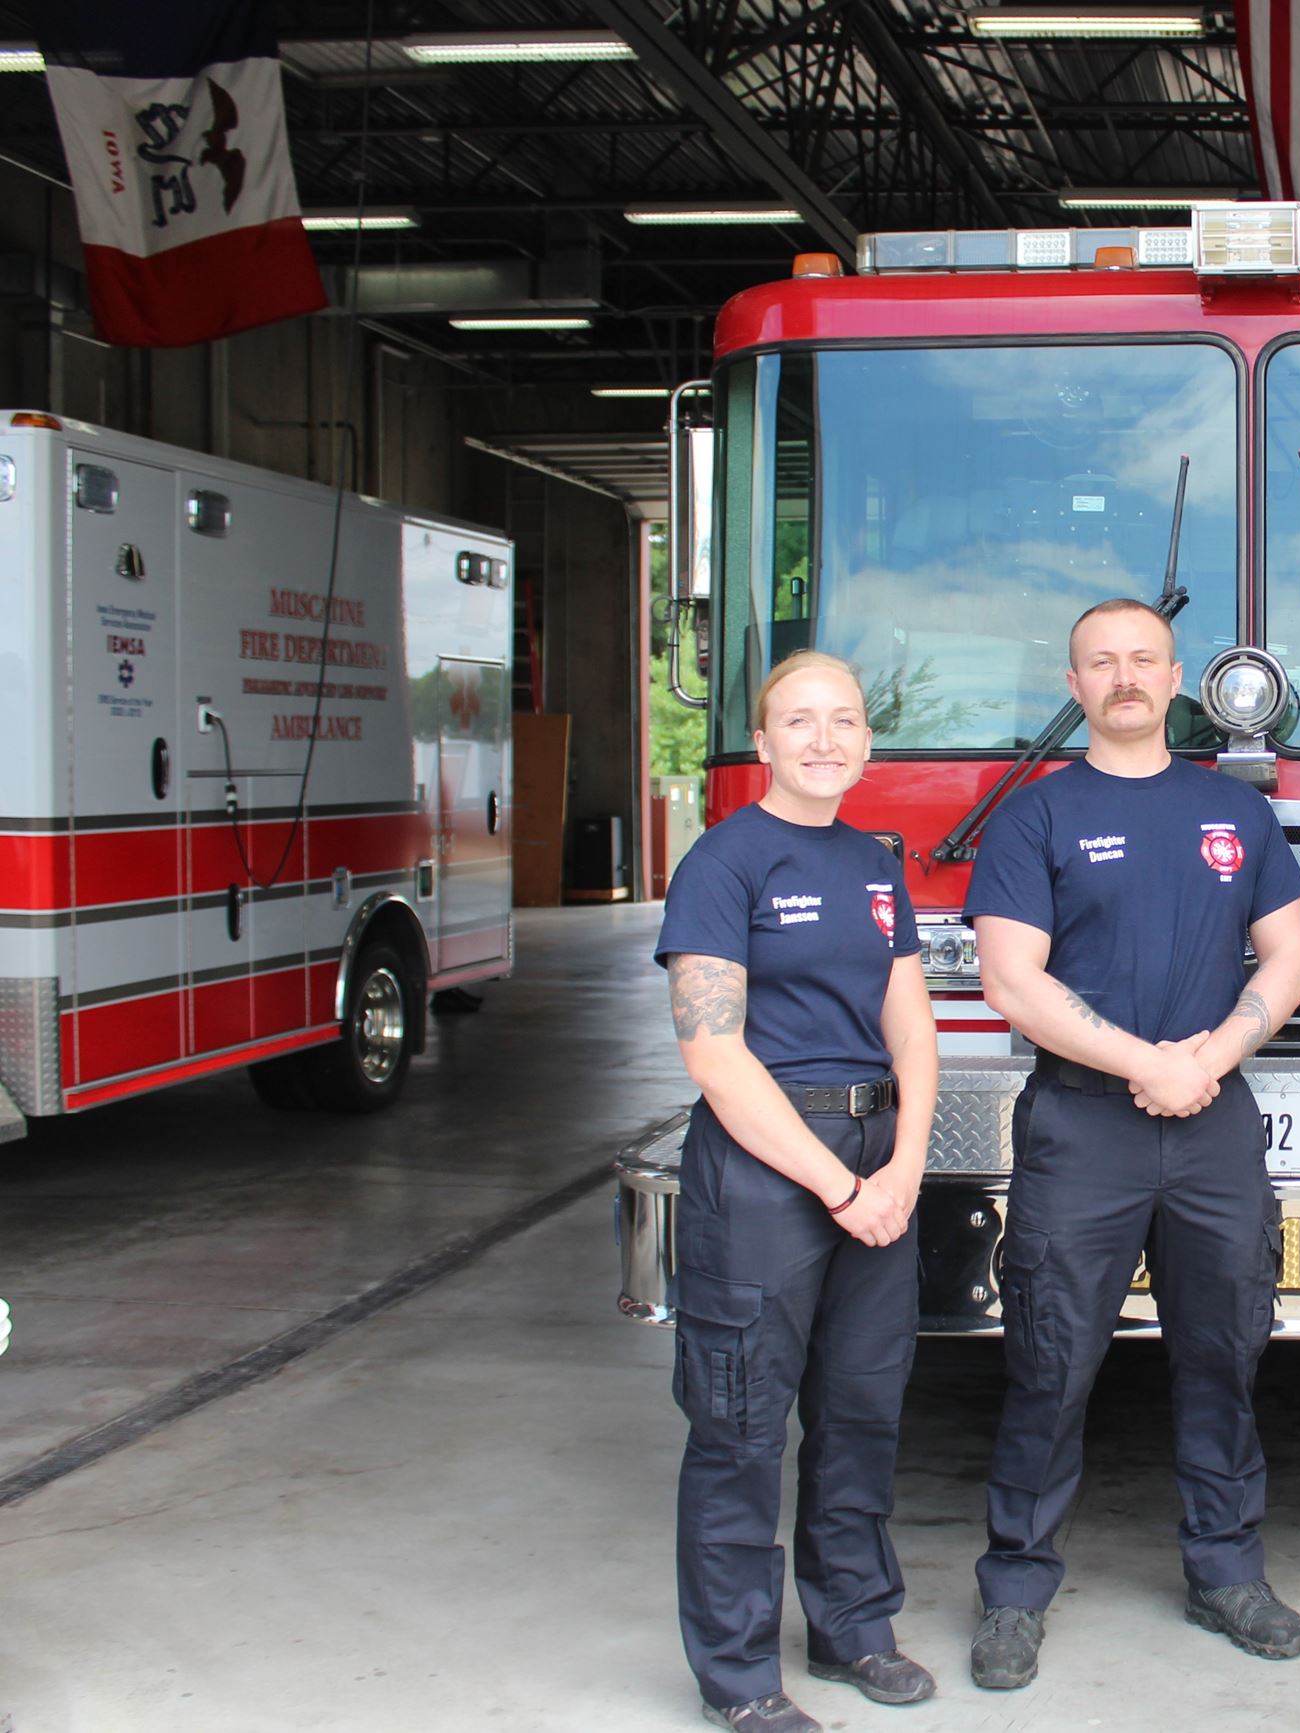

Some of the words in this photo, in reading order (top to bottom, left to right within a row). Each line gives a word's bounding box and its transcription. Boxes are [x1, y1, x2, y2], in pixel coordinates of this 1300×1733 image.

[102, 130, 126, 194] IOWA
[239, 628, 279, 661] FIRE
[271, 714, 362, 741] AMBULANCE
[1079, 835, 1125, 851] Firefighter
[1089, 849, 1124, 863] Duncan
[772, 894, 822, 910] Firefighter
[780, 911, 820, 925] Janssen
